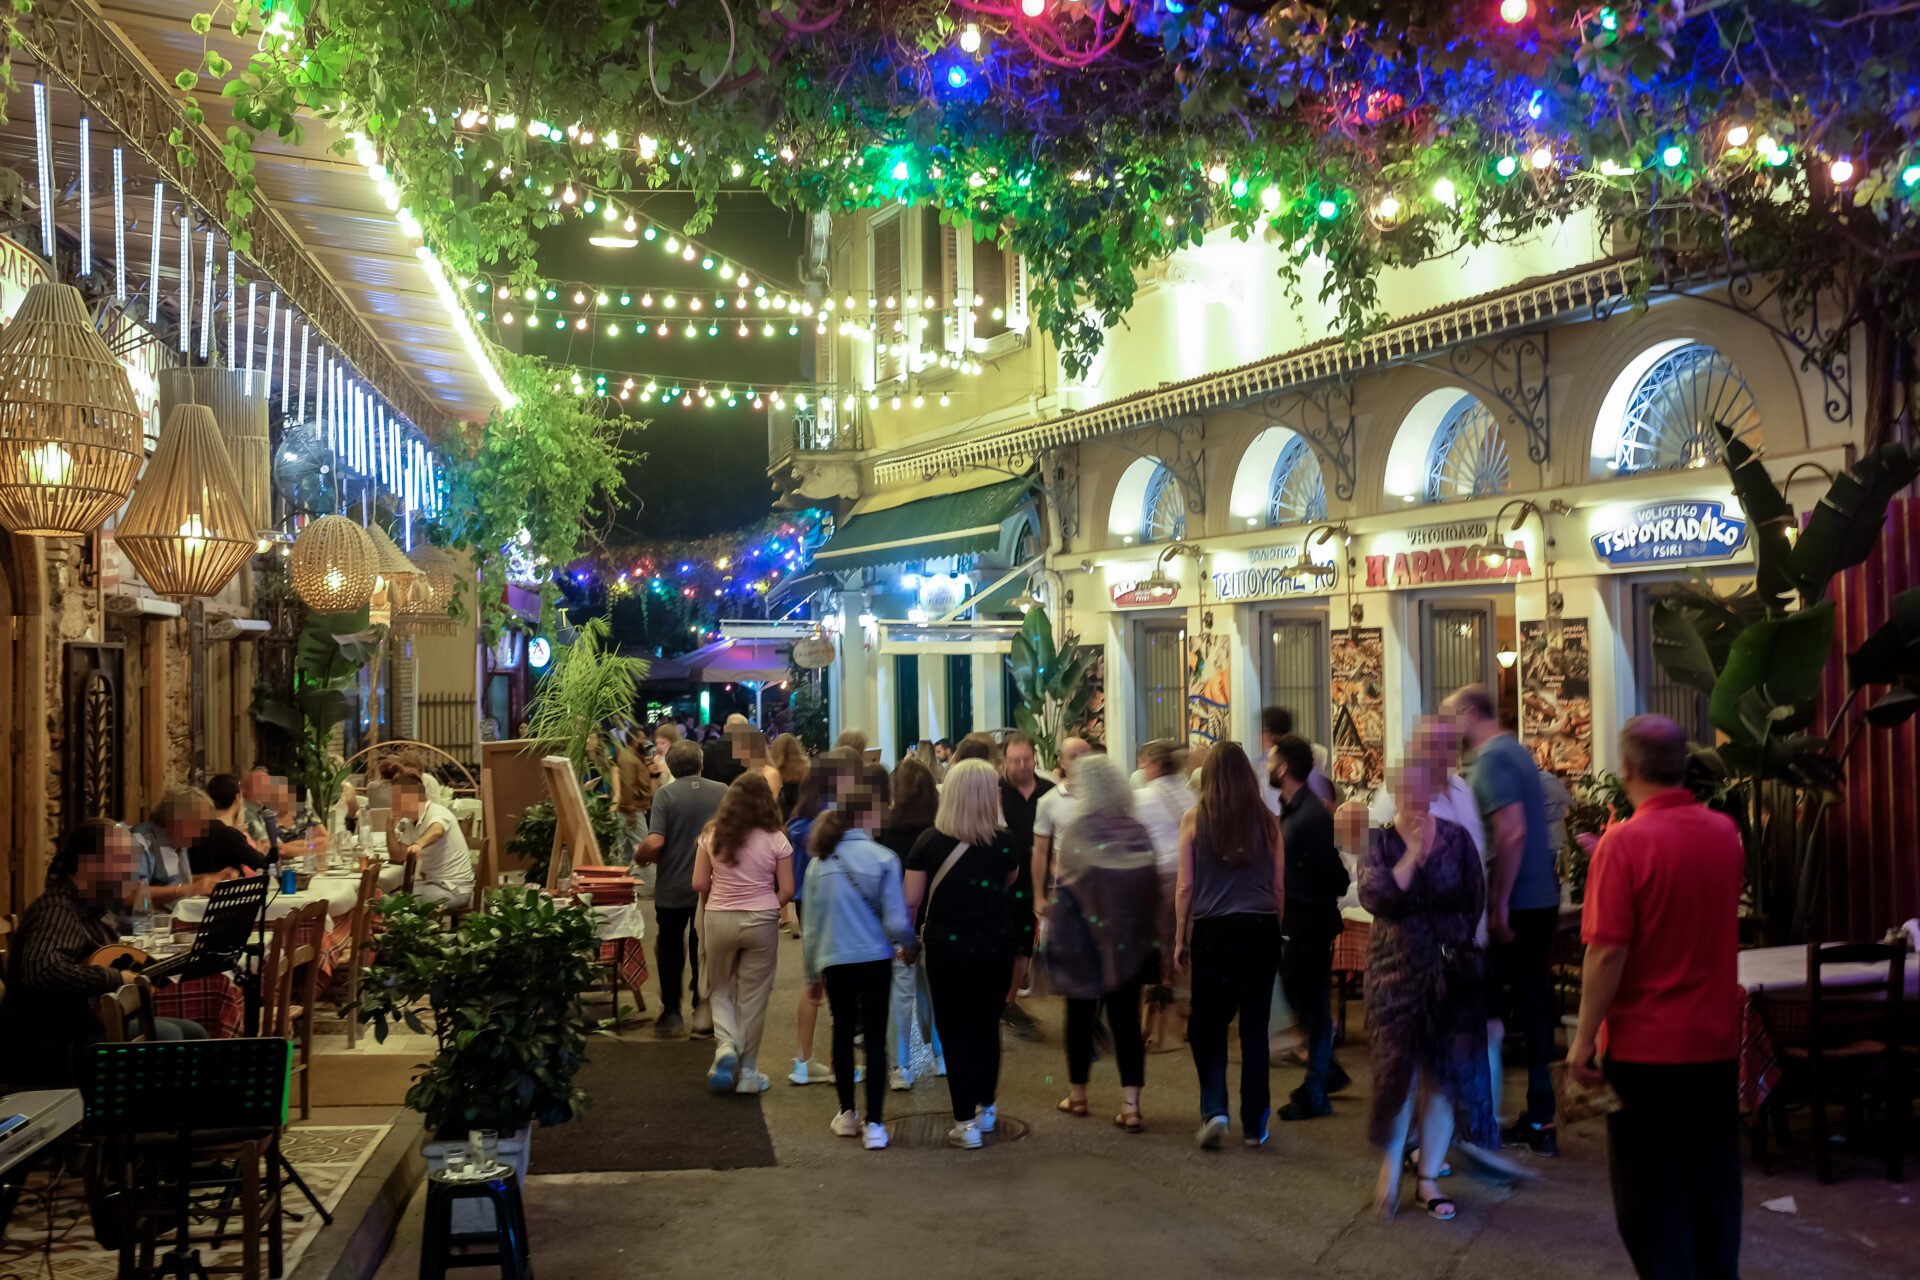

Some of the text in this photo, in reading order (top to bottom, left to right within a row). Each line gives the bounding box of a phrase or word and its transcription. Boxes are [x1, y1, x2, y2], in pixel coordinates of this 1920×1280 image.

[1637, 503, 1698, 523] VOLIOTIKO
[1652, 543, 1682, 559] PSIRI
[1212, 559, 1336, 599] ΤΣΙΠΟΥΡΑΚΟ
[1365, 554, 1388, 588] Η
